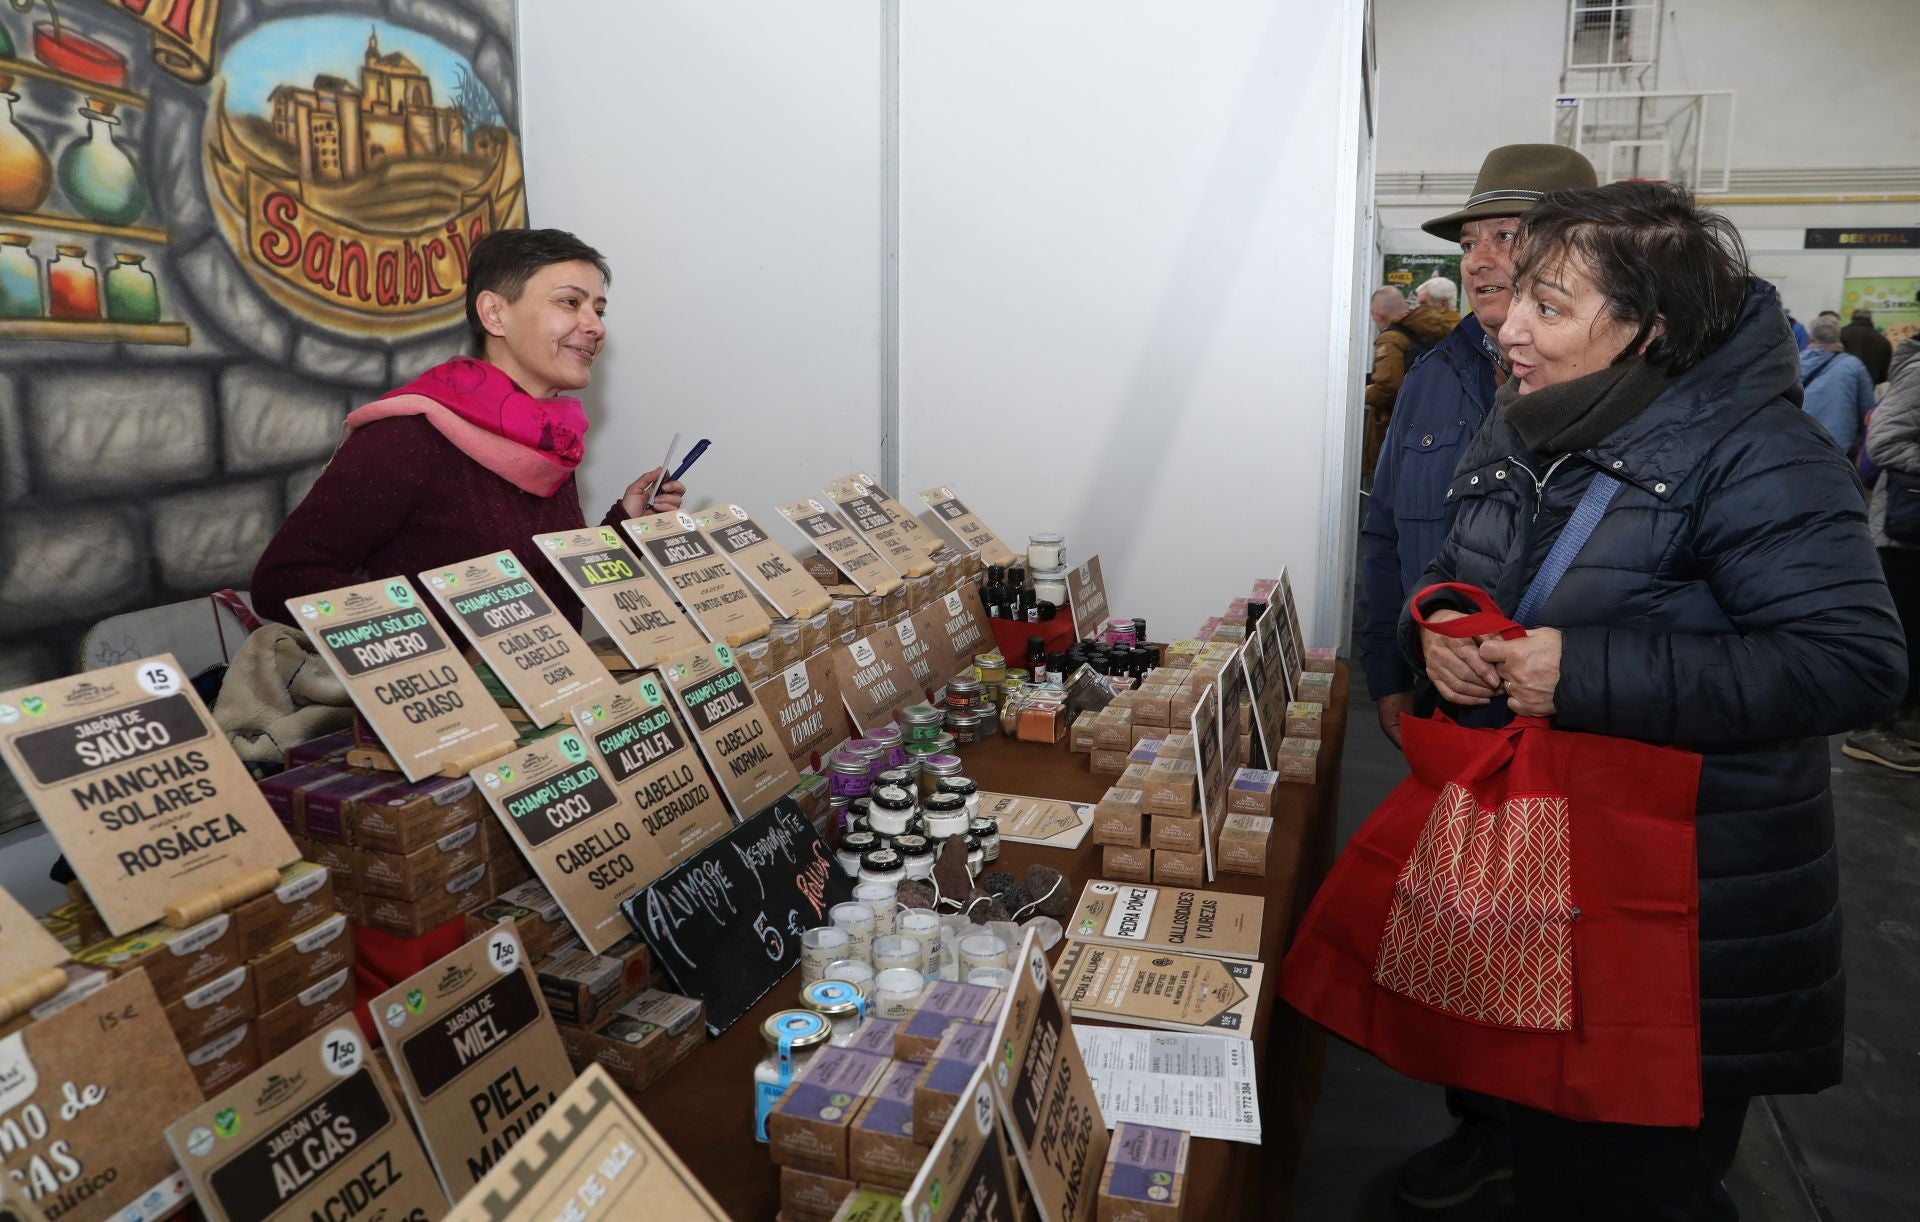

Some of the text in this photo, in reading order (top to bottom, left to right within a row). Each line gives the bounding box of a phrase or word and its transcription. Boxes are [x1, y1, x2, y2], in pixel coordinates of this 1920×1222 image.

[1839, 233, 1907, 244] BEEVITAL
[1402, 257, 1444, 265] Enjambres
[664, 542, 706, 563] ARCILLA
[727, 529, 761, 549] AZUFRE
[500, 558, 515, 569] 10
[581, 558, 633, 585] ALEPO
[672, 564, 731, 589] EXFOLIANTE
[756, 553, 792, 581] ACNÉ
[390, 585, 408, 598] 10
[455, 581, 534, 614] CHAMPÚ SÓLIDO
[613, 588, 652, 611] 40%
[693, 589, 748, 613] PUNTOS NEGROS
[326, 613, 427, 648] CHAMPÚ SÓLIDO
[483, 600, 535, 628] ORTIGA
[618, 610, 675, 635] LAUREL
[353, 631, 428, 668] ROMERO
[498, 624, 562, 655] CAÍDA DEL
[515, 640, 570, 670] CABELLO
[717, 646, 728, 659] 10
[146, 669, 168, 684] 15
[373, 665, 459, 706] CABELLO
[543, 665, 575, 685] CASPA
[643, 683, 657, 697] 10
[684, 671, 742, 709] CHAMPÚ SÓLIDO
[852, 657, 894, 691] BÁLSAMO de
[403, 690, 464, 724] GRASO
[869, 678, 898, 704] ORTIGA
[75, 710, 145, 738] JABÓN DE
[702, 695, 745, 725] ABEDUL
[779, 689, 825, 728] BÁLSAMO de
[75, 721, 170, 766] SAÚCO
[599, 709, 672, 757] CHAMPÚ SÓLIDO
[715, 719, 764, 757] CABELLO
[790, 711, 823, 747] ROMERO
[566, 739, 580, 753] 10
[619, 731, 675, 774] ALFALFA
[728, 746, 773, 779] NORMAL
[71, 750, 209, 811] MANCHAS
[507, 766, 600, 819] CHAMPÚ SÓLIDO
[634, 764, 695, 810] CABELLO
[99, 778, 217, 831] SOLARES
[545, 794, 592, 829] COCO
[641, 785, 710, 837] QUEBRADIZO
[117, 813, 247, 876] ROSÁCEA
[555, 822, 632, 876] CABELLO
[588, 853, 635, 891] SECO
[1096, 884, 1110, 892] 5
[646, 858, 738, 967] ALUMBRE
[1123, 887, 1149, 912] PÓMEZ
[1118, 911, 1141, 938] PIEDRA
[1168, 892, 1195, 944] CALLOSIDADES
[1197, 900, 1218, 933] DUREZAS
[492, 941, 514, 960] 7,50
[753, 908, 807, 960] 5 €
[1084, 973, 1094, 984] DE
[1086, 950, 1105, 974] ALUMBRE
[1072, 983, 1089, 1001] PIEDRA
[445, 993, 496, 1037] JABÓN DE
[327, 1040, 355, 1063] 7,50
[452, 1018, 508, 1065] MIEL
[1025, 1021, 1059, 1124] LAVANDA
[1242, 1082, 1251, 1096] 384
[60, 1080, 107, 1121] de
[469, 1066, 540, 1135] PIEL
[1040, 1055, 1071, 1166] PIERNAS
[1243, 1094, 1252, 1111] 772
[1243, 1110, 1253, 1123] 661
[267, 1103, 333, 1158] JABÓN DE
[1055, 1096, 1081, 1180] Y PIES
[270, 1114, 358, 1199] ALGAS
[1061, 1105, 1094, 1222] CANSADOS
[311, 1151, 403, 1222] ACIDEZ
